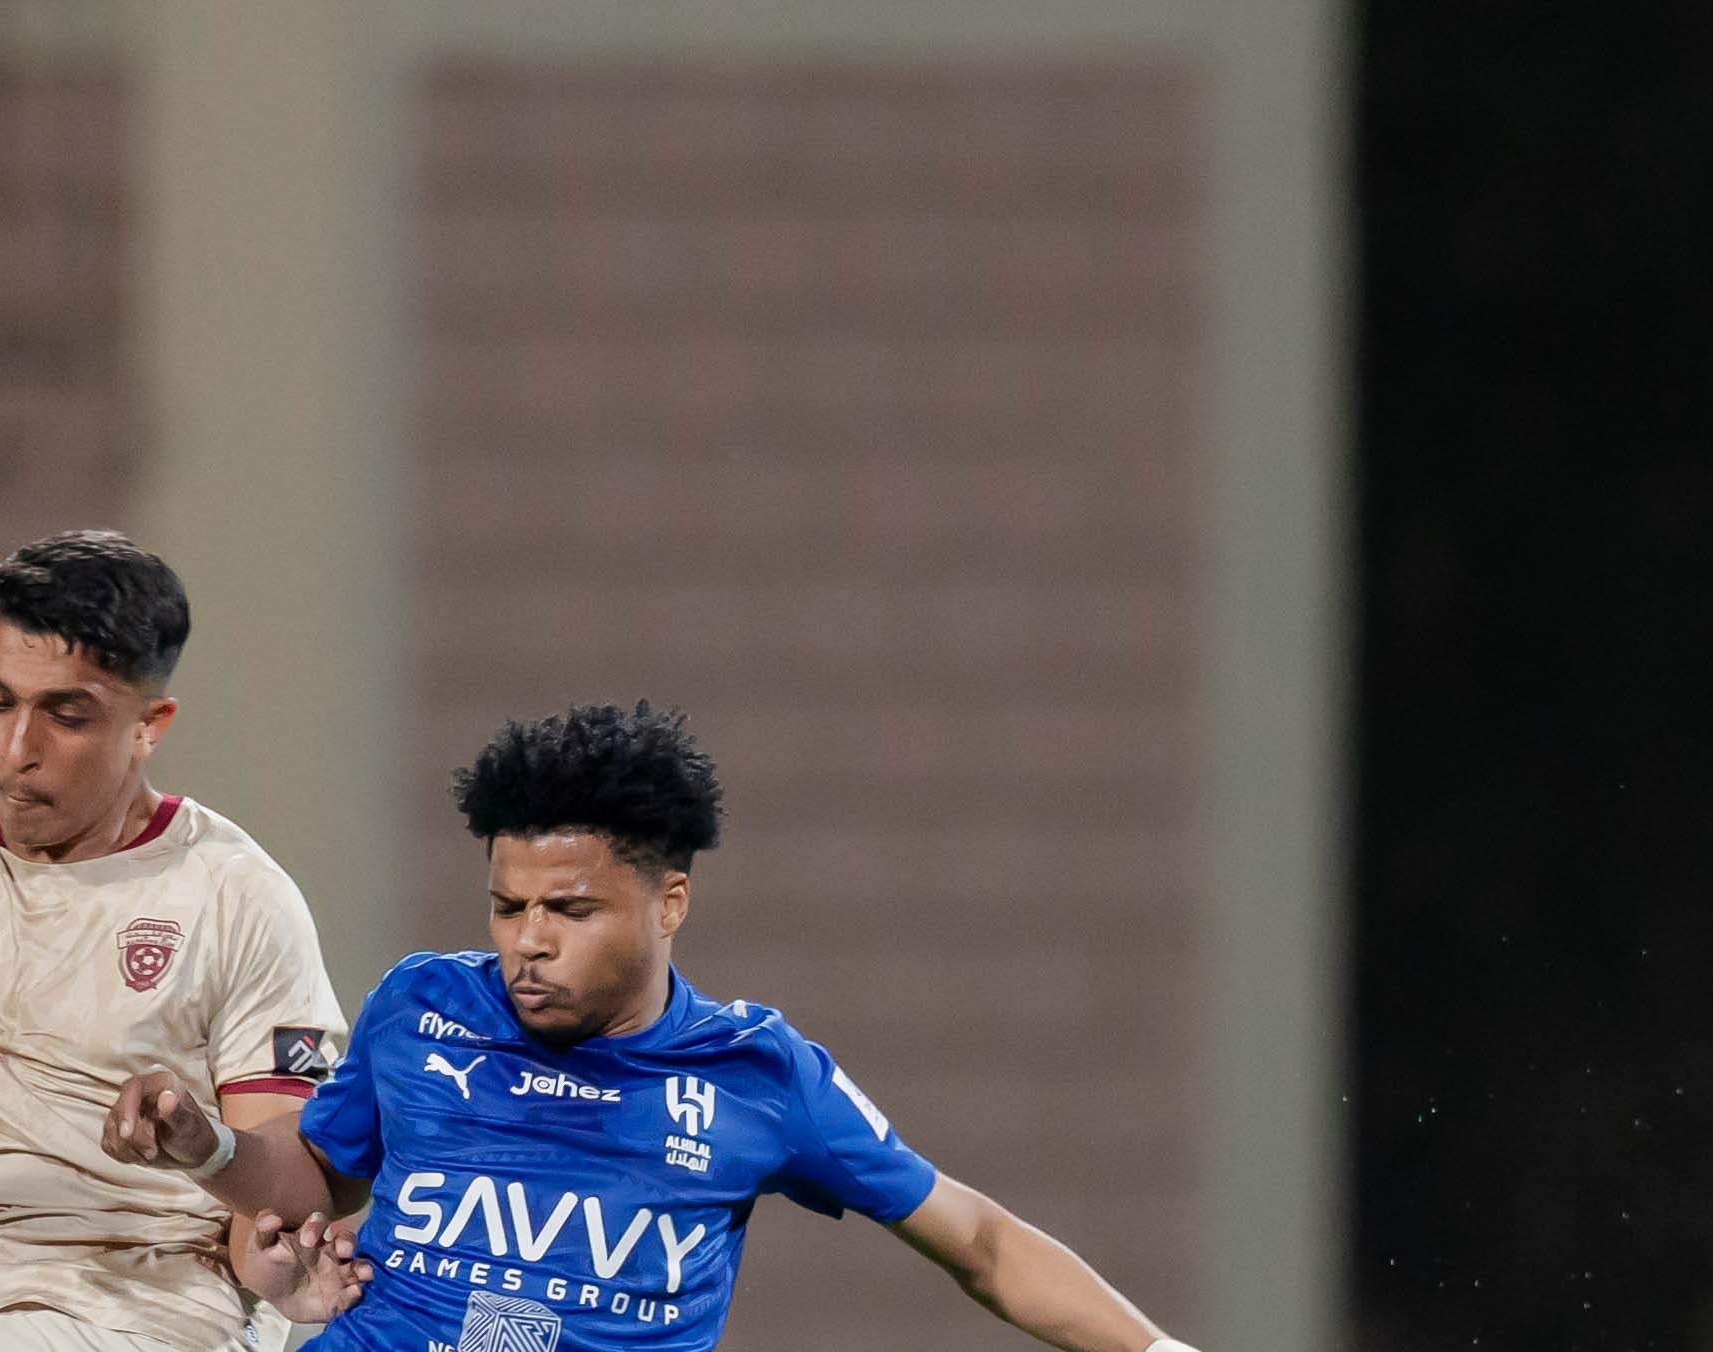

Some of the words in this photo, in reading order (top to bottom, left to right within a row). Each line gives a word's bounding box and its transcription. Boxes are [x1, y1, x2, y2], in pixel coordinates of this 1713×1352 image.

[510, 1071, 622, 1102] Jahez
[394, 1172, 707, 1294] SAVVY
[385, 1250, 523, 1291] GAMES
[546, 1277, 680, 1326] GROUP
